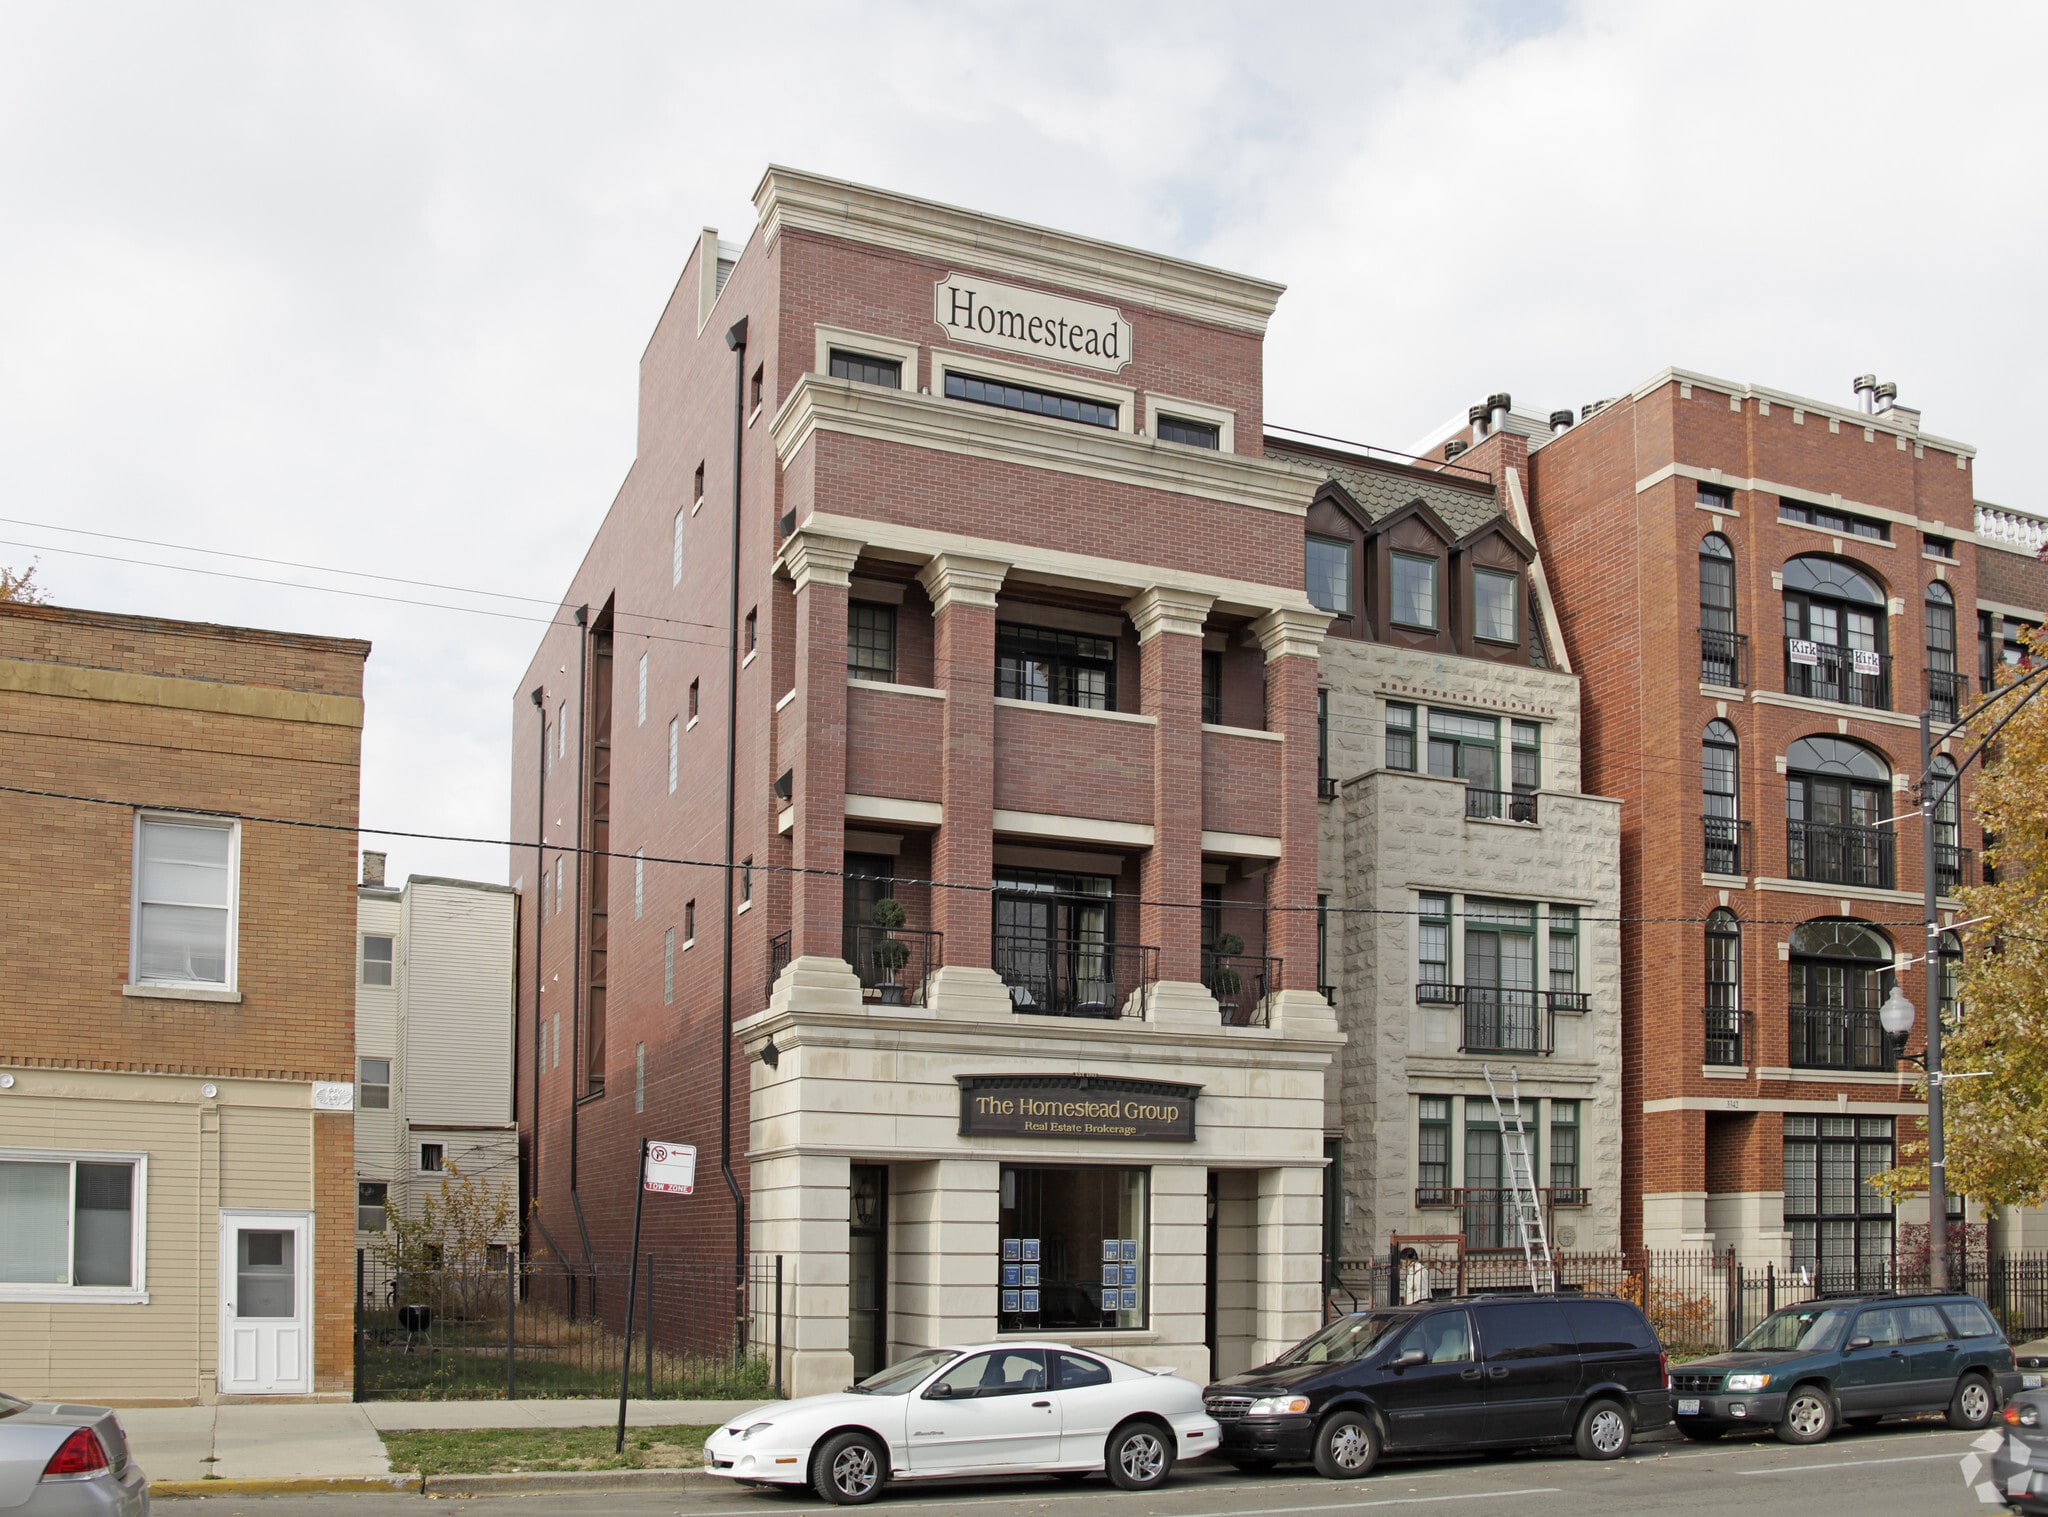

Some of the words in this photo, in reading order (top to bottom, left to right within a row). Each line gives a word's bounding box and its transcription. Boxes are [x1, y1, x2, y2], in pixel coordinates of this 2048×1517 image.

[948, 286, 1120, 359] Homestead
[1791, 640, 1816, 656] Kirk
[1855, 651, 1879, 666] Kirk
[976, 1096, 1014, 1115] The
[1019, 1098, 1121, 1119] Homestead
[1124, 1101, 1179, 1123] Group
[1024, 1121, 1048, 1132] Real
[1050, 1122, 1082, 1133] Estate
[1084, 1123, 1137, 1136] Brokerage
[667, 1184, 688, 1193] ZONE
